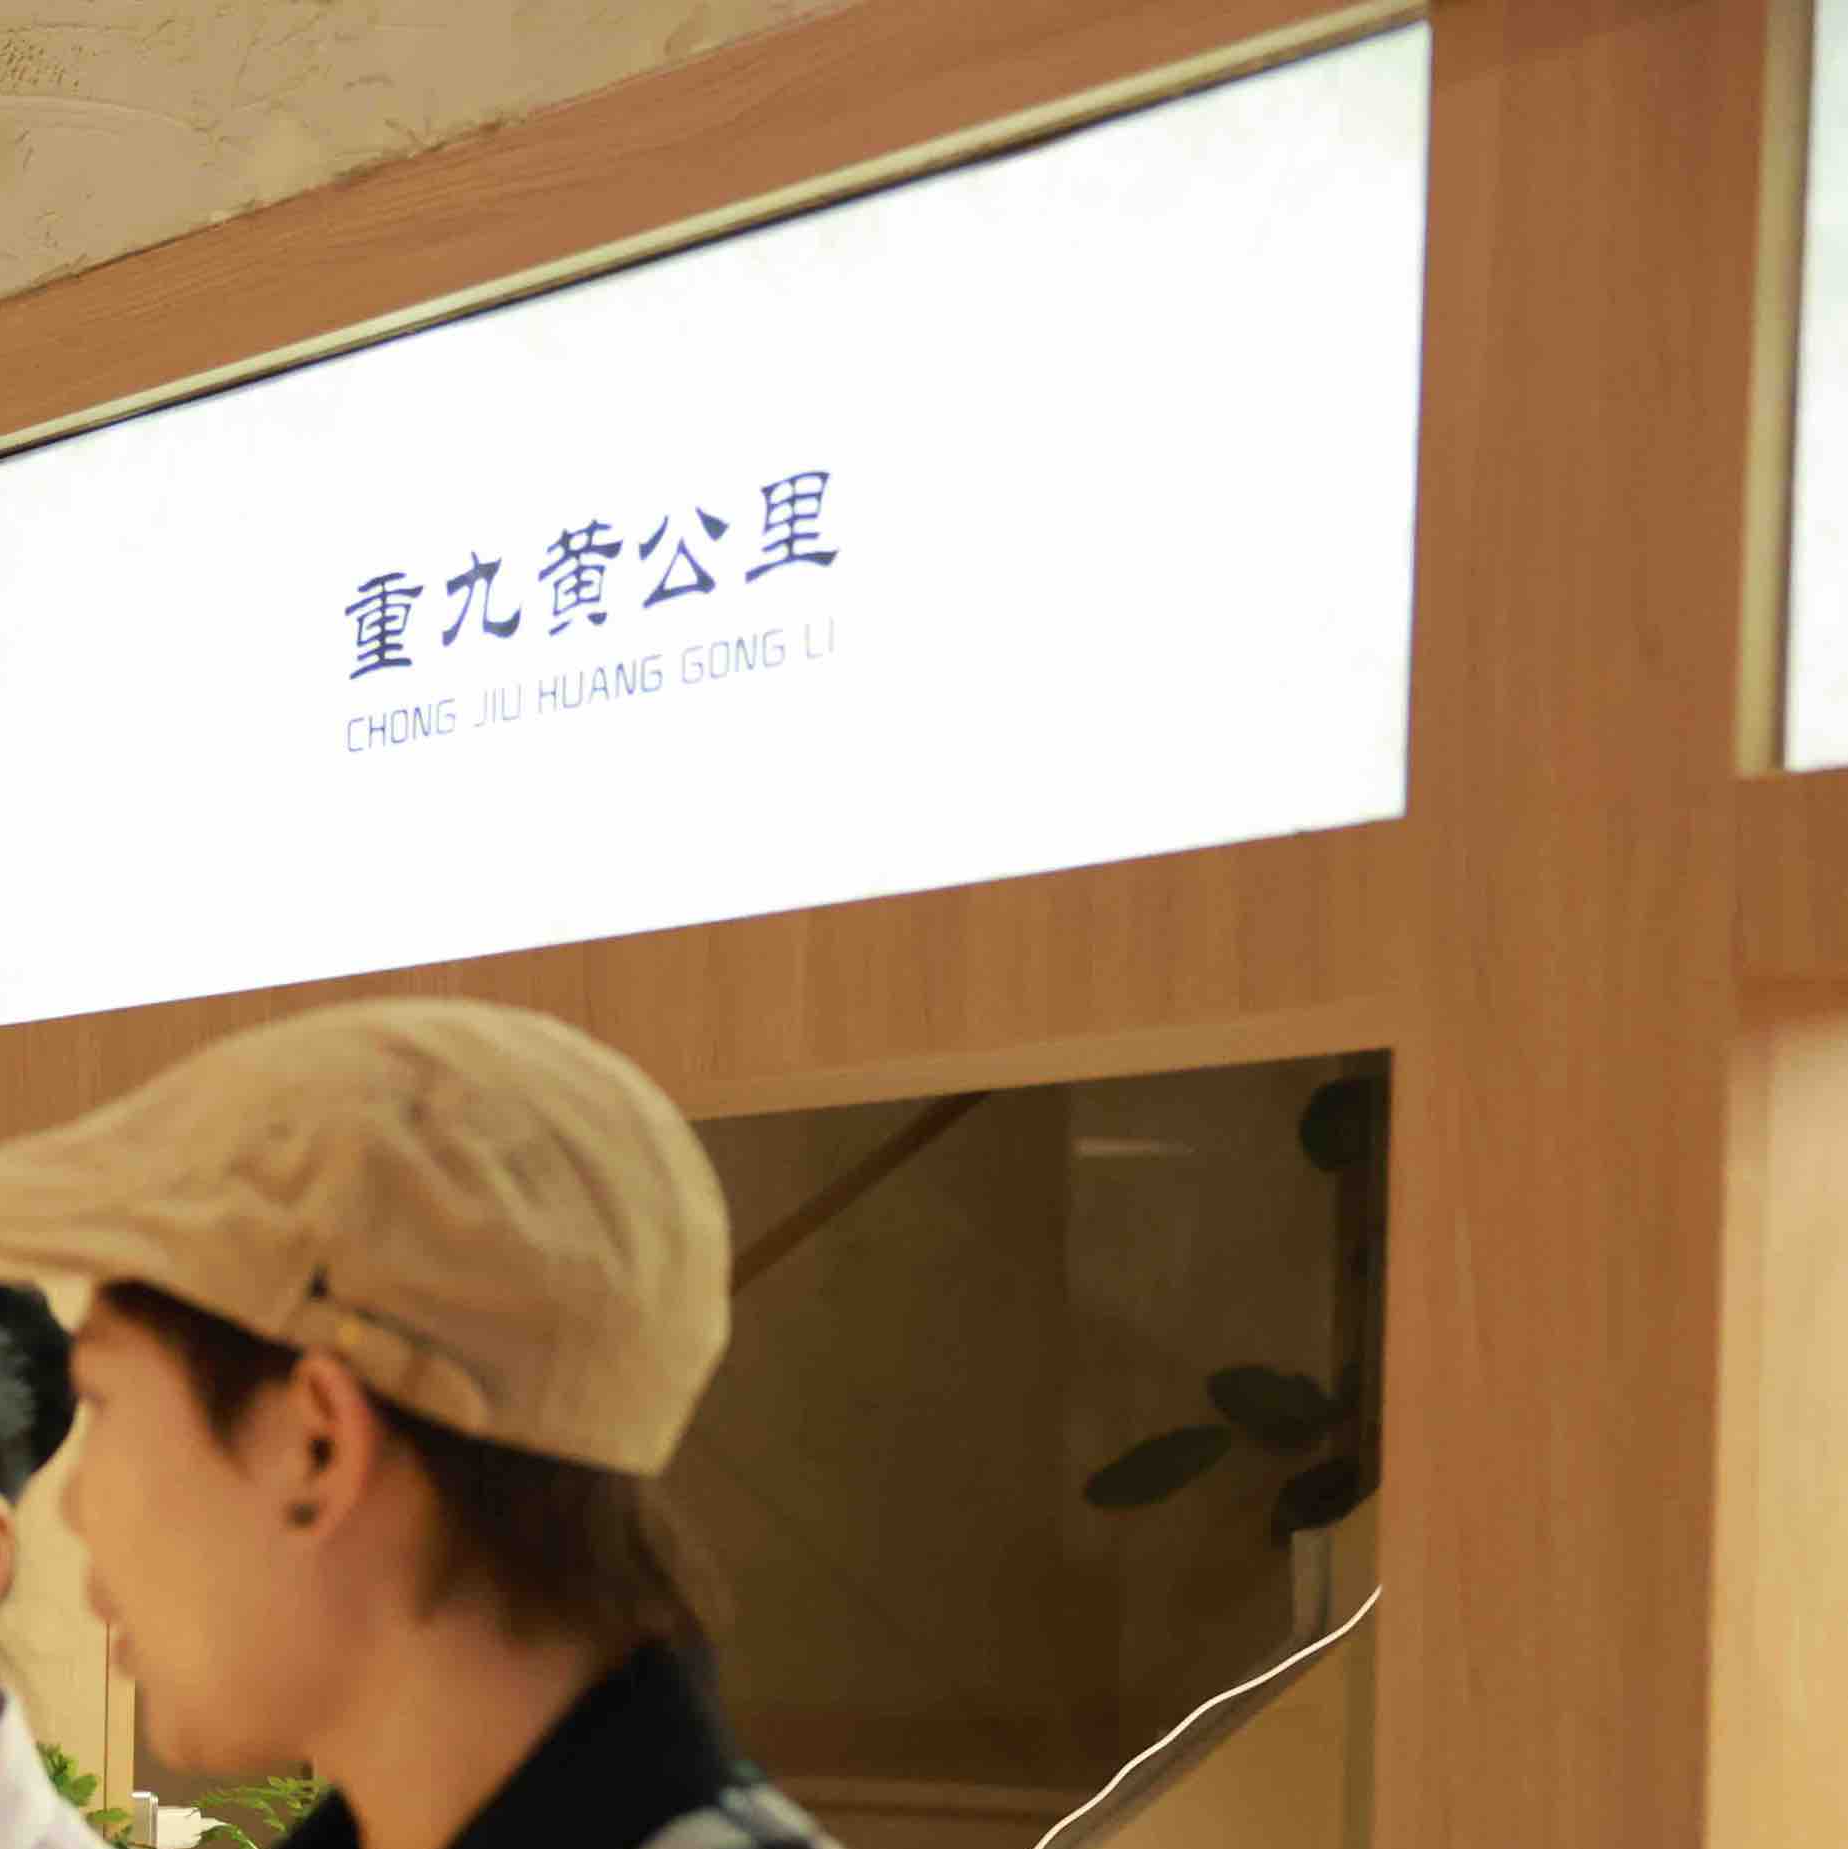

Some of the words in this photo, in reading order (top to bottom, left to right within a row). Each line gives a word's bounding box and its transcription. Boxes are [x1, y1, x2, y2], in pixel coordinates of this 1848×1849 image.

[344, 468, 841, 681] 重九黄公里
[346, 697, 456, 753] CHONG
[473, 683, 522, 728] JIU
[537, 653, 664, 714] HUANG
[680, 628, 786, 685] GONG
[804, 618, 835, 660] LI
